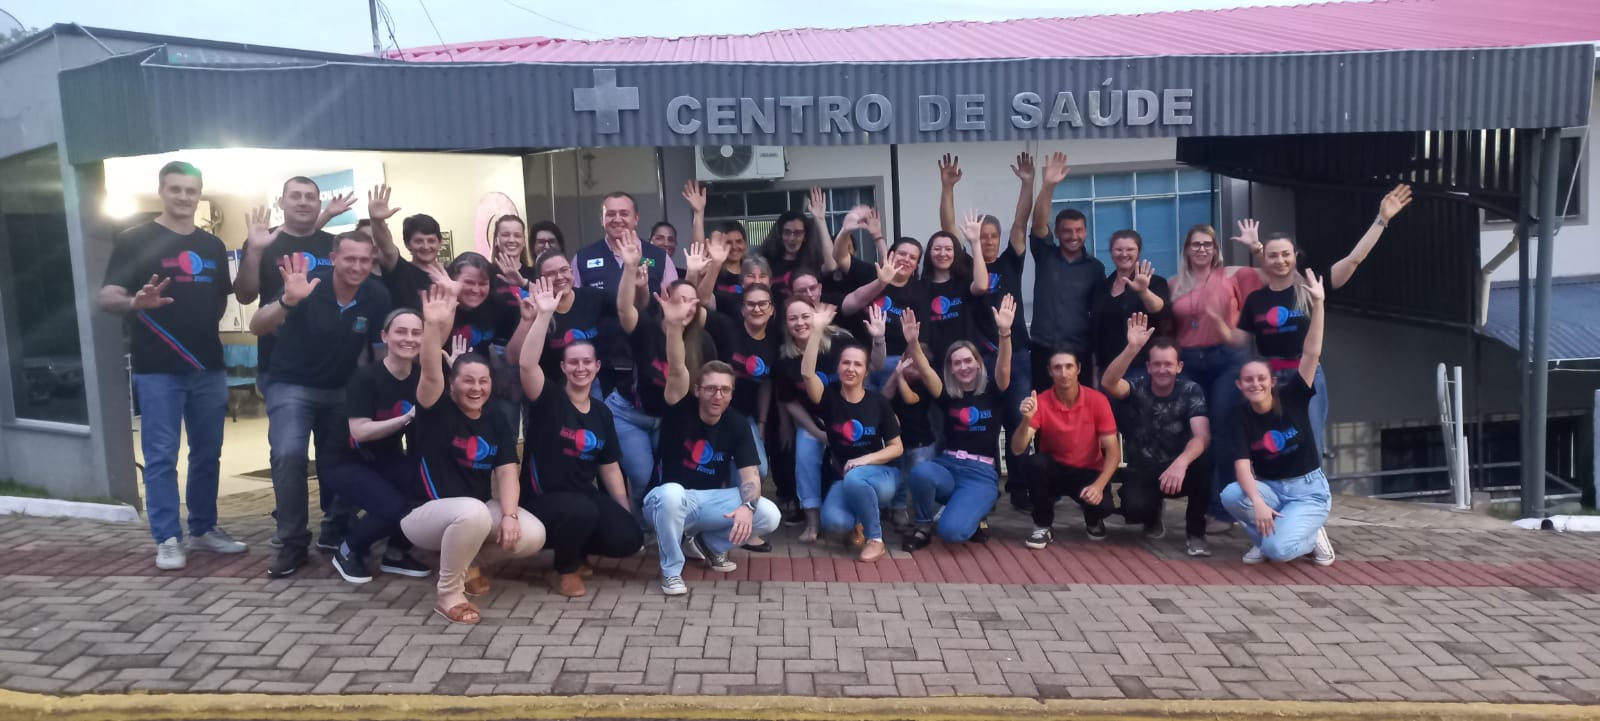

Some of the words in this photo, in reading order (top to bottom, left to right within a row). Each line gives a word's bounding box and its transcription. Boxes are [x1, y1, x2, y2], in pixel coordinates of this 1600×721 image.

[666, 93, 893, 135] CENTRO
[918, 94, 985, 131] DE
[1011, 77, 1193, 128] SAÚDE
